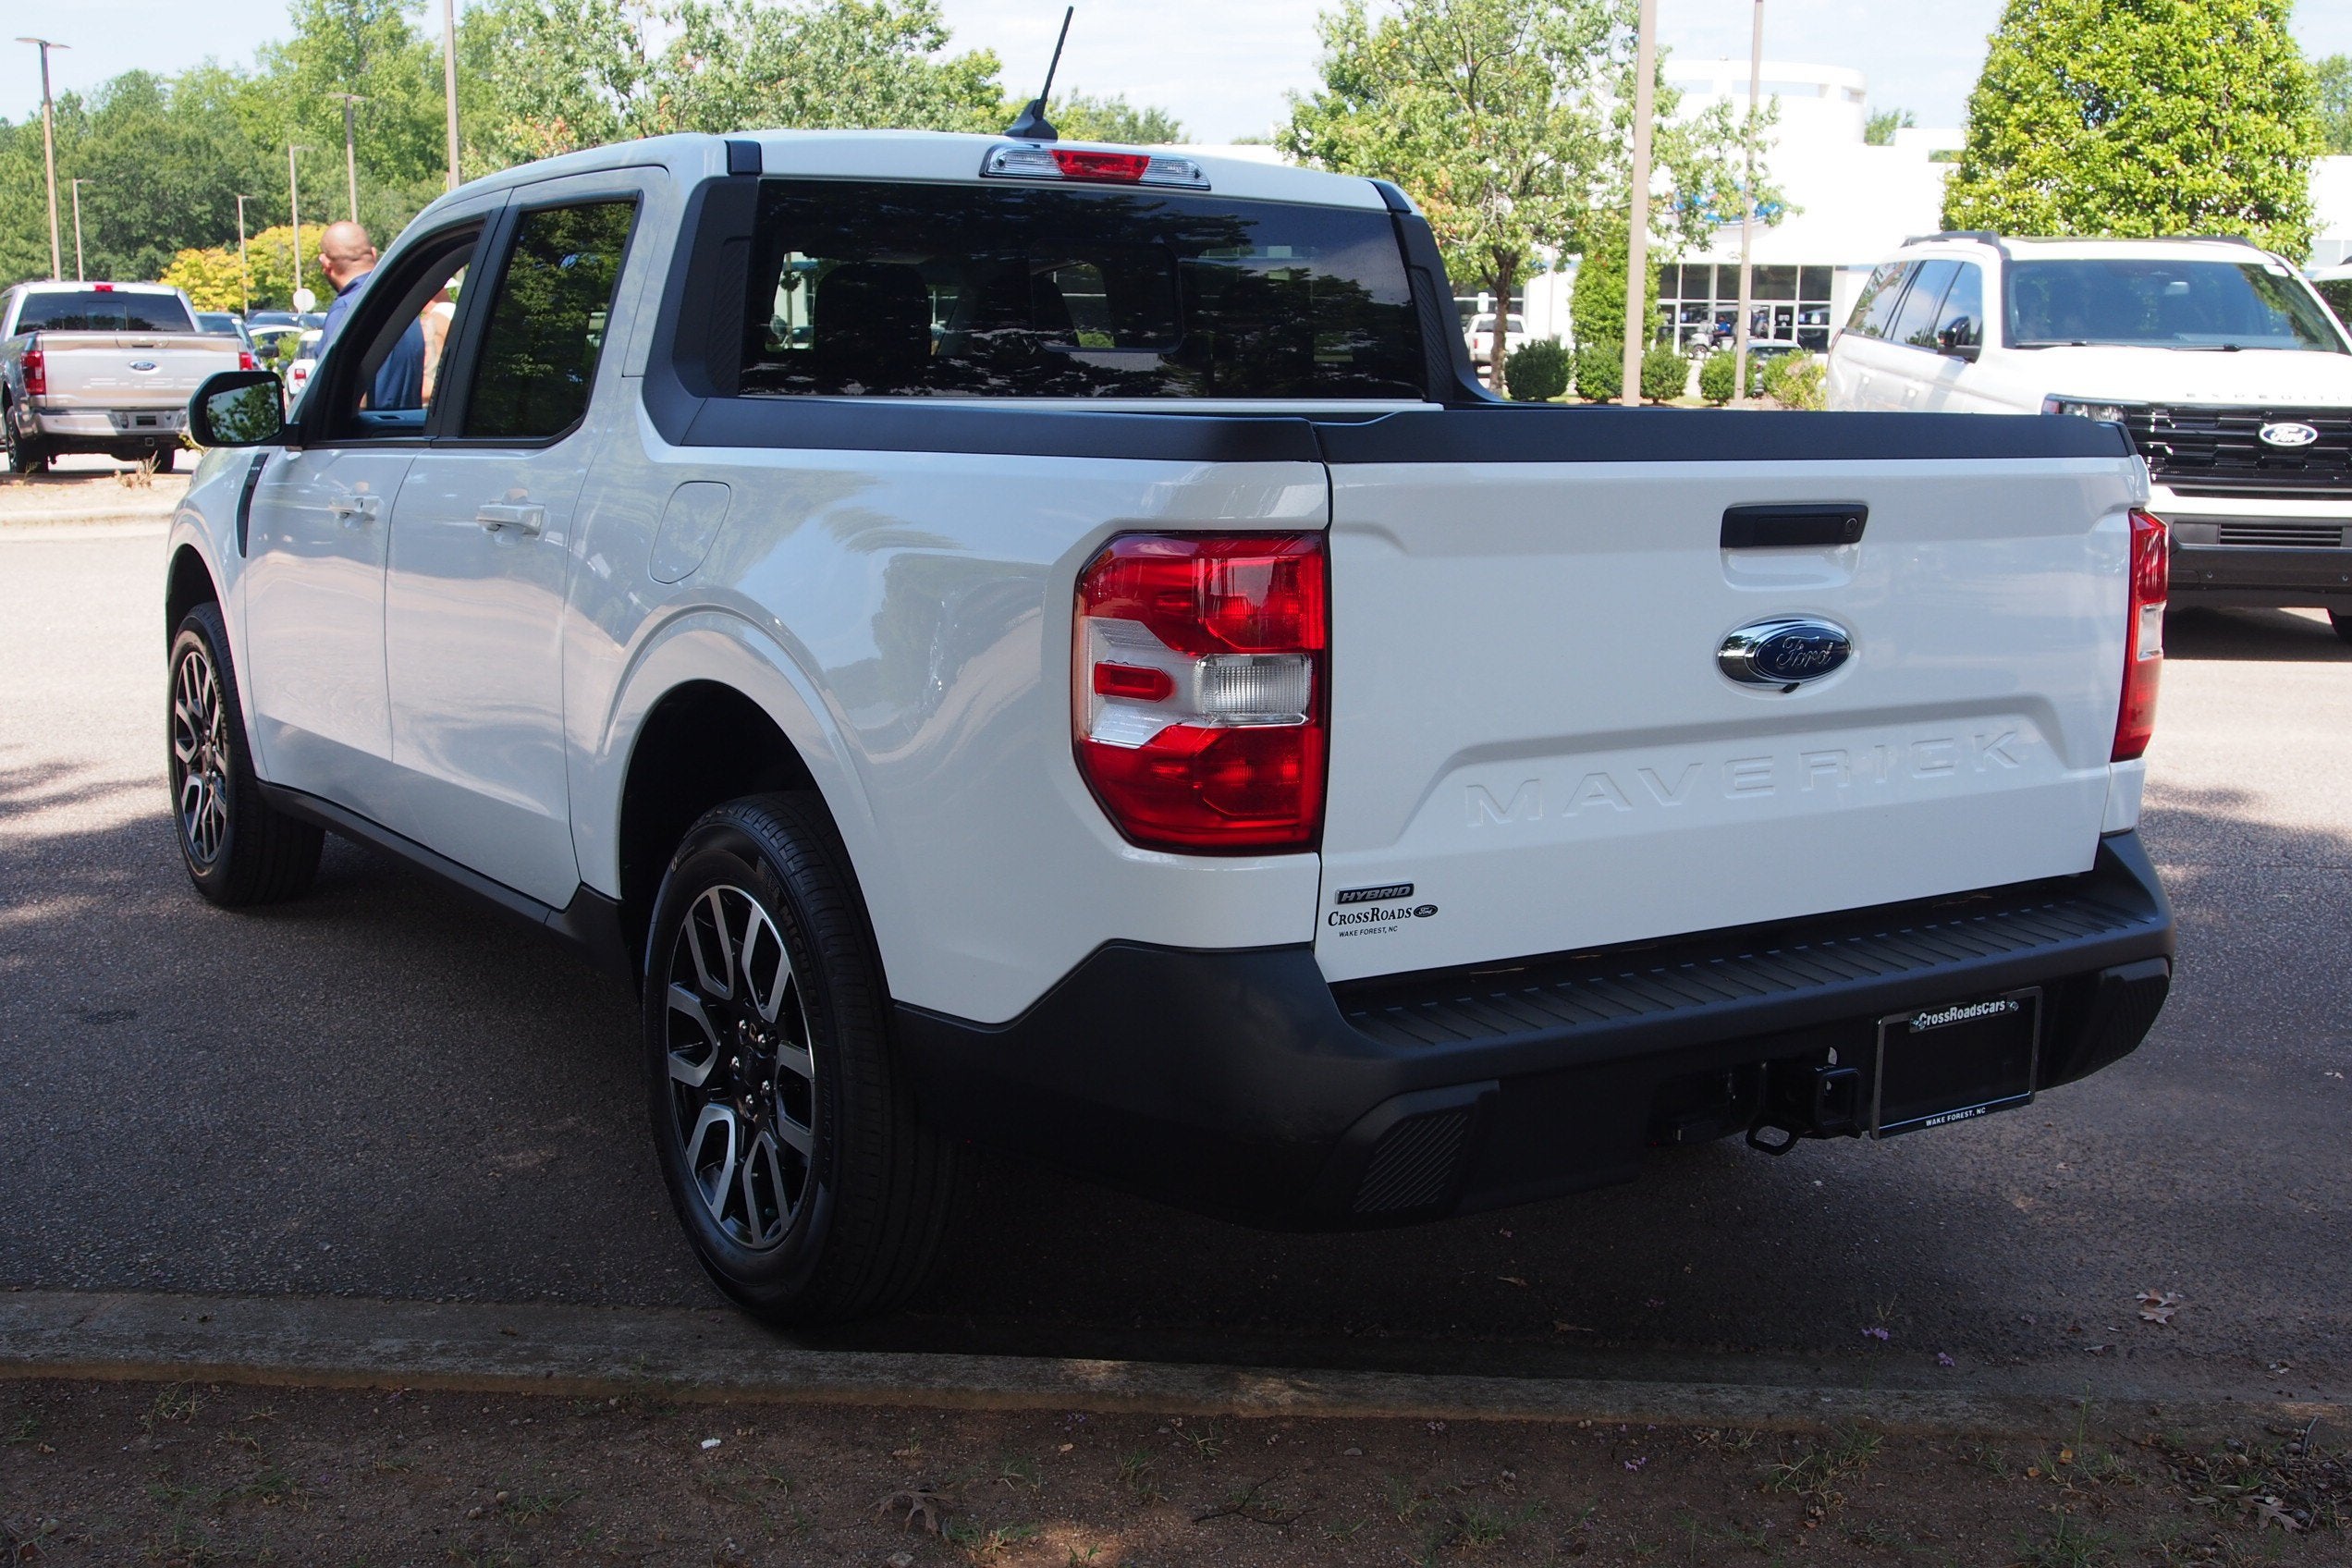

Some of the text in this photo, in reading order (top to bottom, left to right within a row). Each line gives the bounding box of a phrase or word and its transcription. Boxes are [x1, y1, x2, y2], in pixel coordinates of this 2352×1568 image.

[2270, 425, 2307, 443] Ford
[1776, 635, 1834, 668] Ford
[1464, 730, 2020, 828] MAVERICK
[1341, 886, 1411, 902] HYBRID
[1339, 929, 1358, 937] WAKE
[1359, 926, 1387, 936] FOREST,
[1918, 999, 2006, 1025] CrossRoadsCars
[1926, 1116, 1945, 1126] WAKE
[1947, 1110, 1975, 1121] FOREST,
